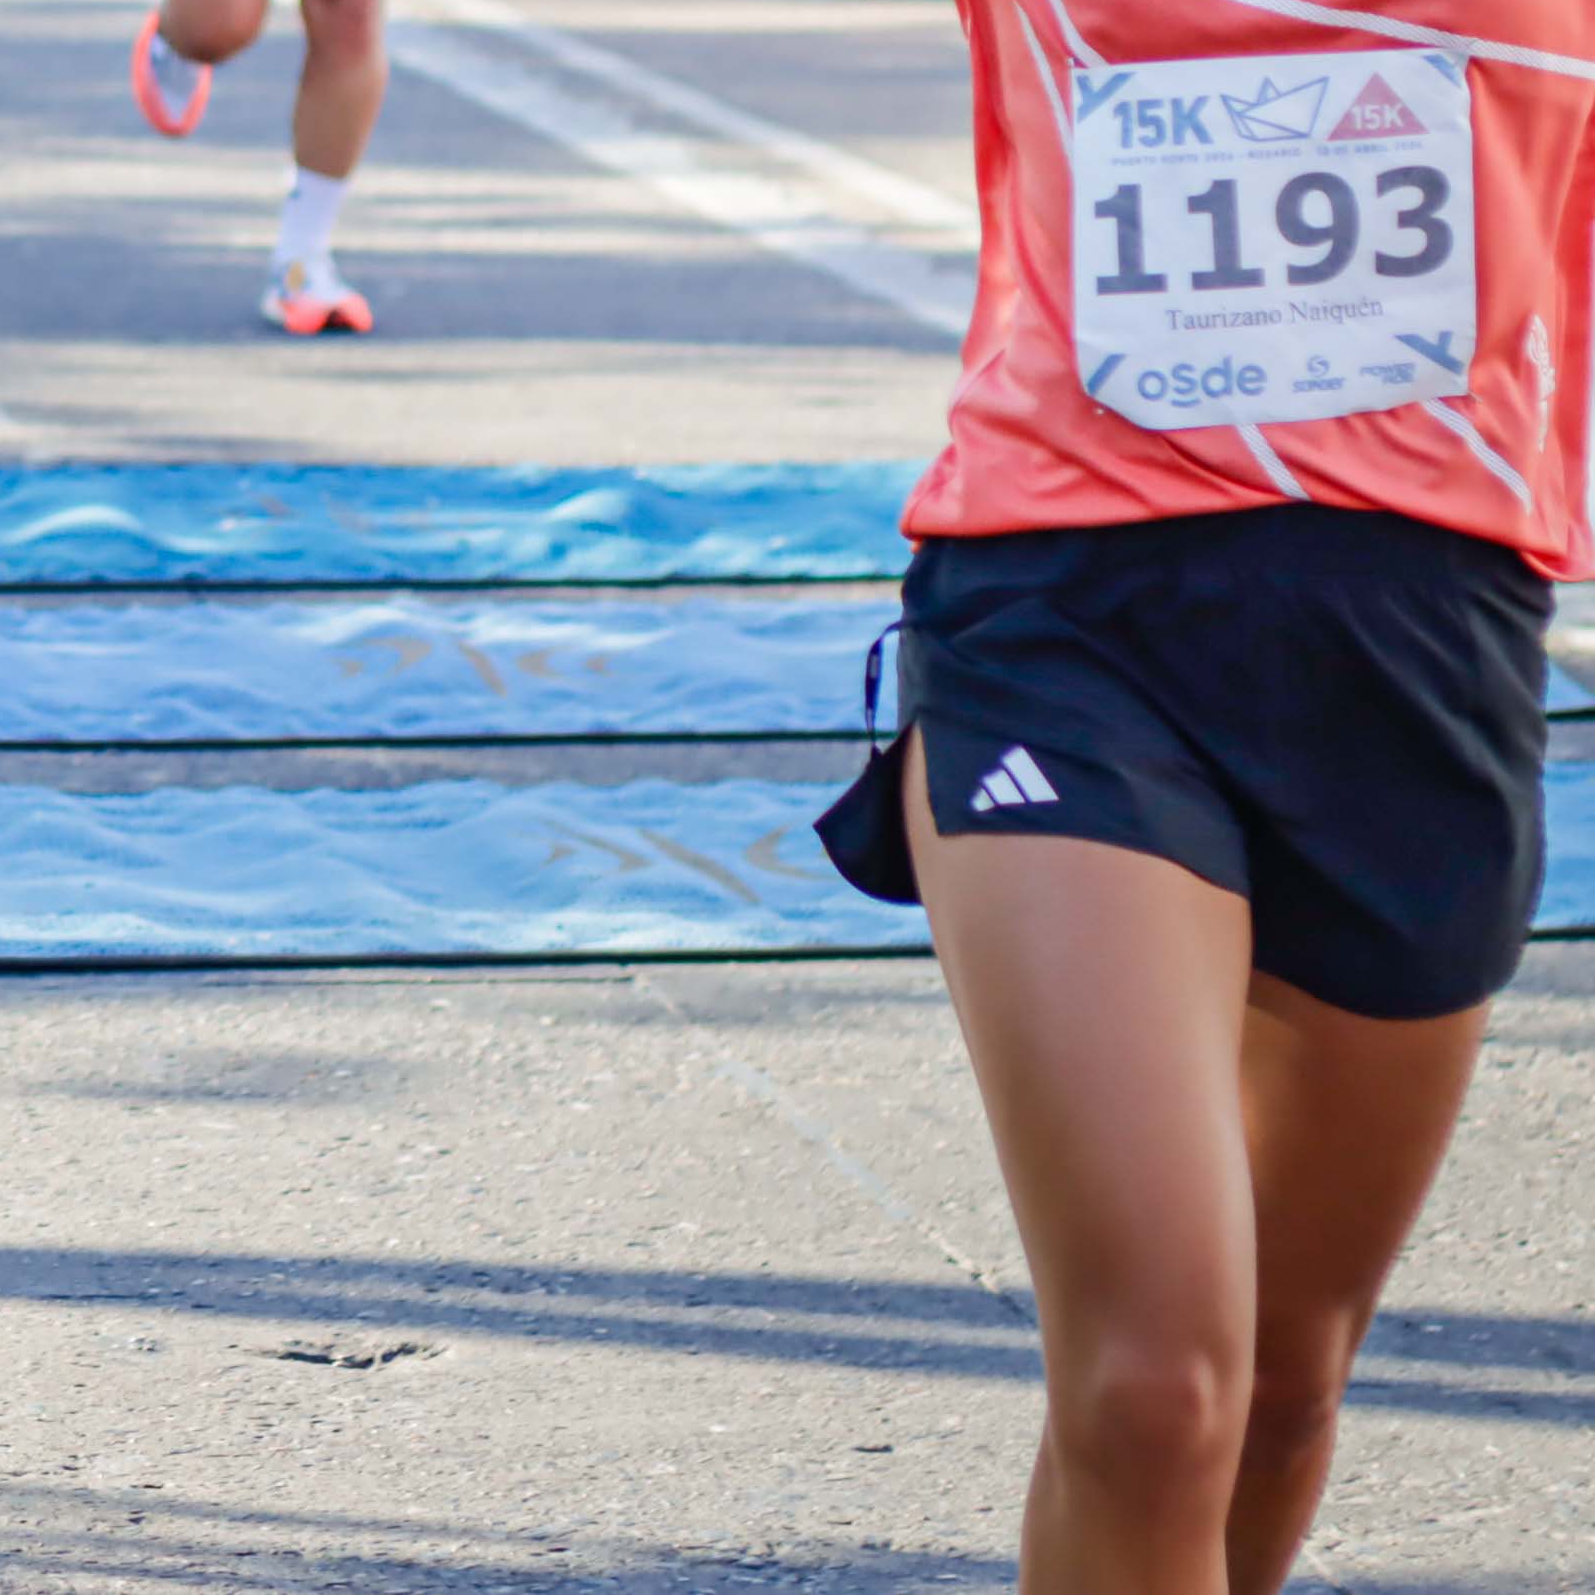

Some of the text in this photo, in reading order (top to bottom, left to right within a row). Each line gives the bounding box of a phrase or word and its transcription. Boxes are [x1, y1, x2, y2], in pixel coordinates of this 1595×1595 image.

[1112, 95, 1214, 150] 15K
[1352, 104, 1407, 130] 15K
[1094, 165, 1454, 297] 1193
[1166, 308, 1282, 331] Taurizano
[1137, 355, 1266, 407] osde
